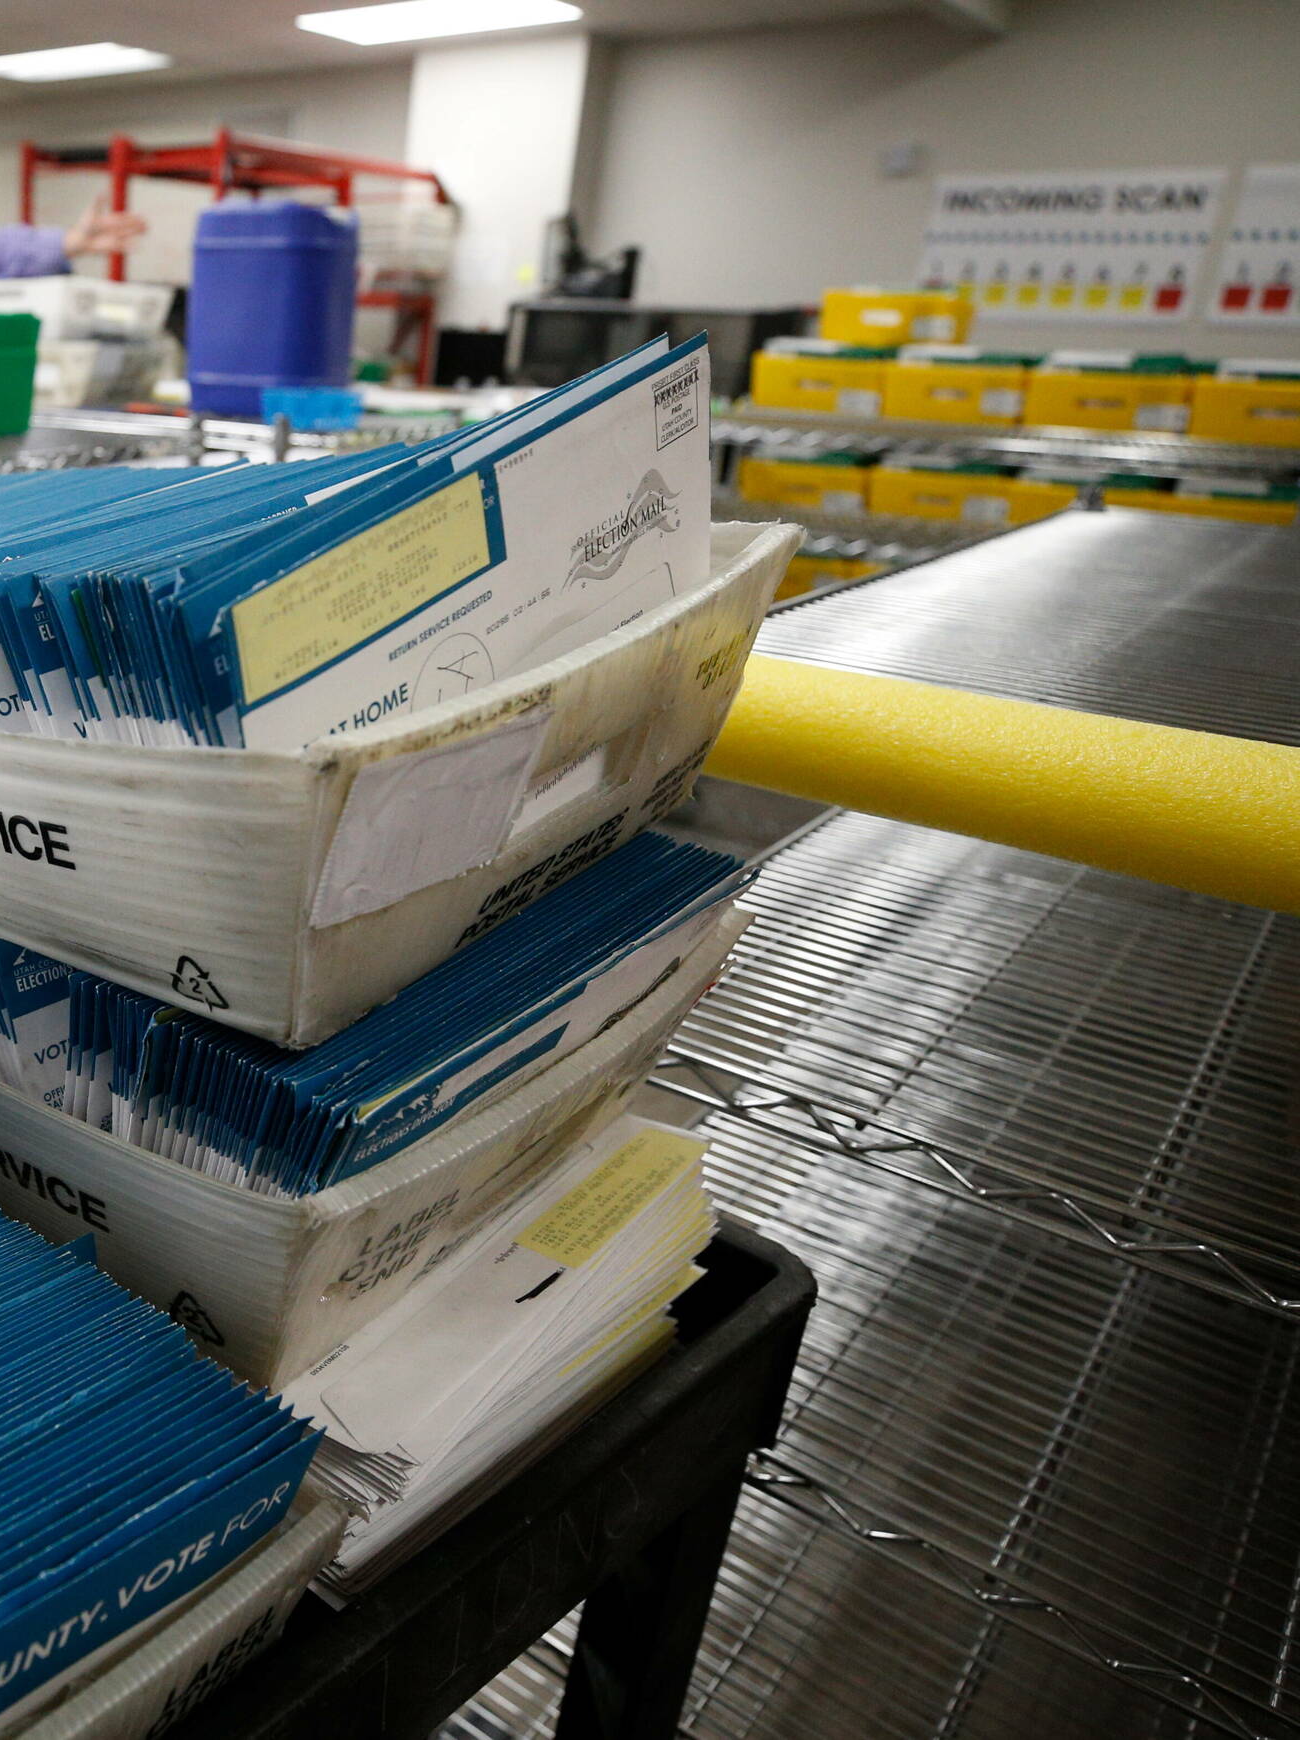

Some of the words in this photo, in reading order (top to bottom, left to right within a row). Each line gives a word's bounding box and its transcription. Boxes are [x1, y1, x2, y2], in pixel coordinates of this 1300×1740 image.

[946, 184, 1104, 215] INCOMING
[1115, 182, 1208, 214] SCAN
[674, 408, 692, 424] COUNTY
[576, 510, 625, 547] OFFICIAL
[639, 495, 667, 525] MAIL
[583, 516, 638, 562] ELECTION
[388, 636, 417, 662] RETURN
[419, 617, 451, 648] SERVICE
[451, 589, 493, 623] REQUESTED
[353, 682, 409, 731] HOME
[477, 856, 554, 916] UNITED
[552, 806, 626, 867] STATES
[454, 892, 533, 950] POSTAL
[538, 830, 622, 894] SERVICE
[13, 963, 36, 977] UTAH
[15, 963, 75, 993] ELECTIONS
[33, 1039, 71, 1065] VOT
[353, 1125, 411, 1163] ELECTIONS
[358, 1189, 460, 1257] LABEL
[117, 1533, 216, 1609] VOTE
[220, 1480, 290, 1548] FOR
[161, 1606, 275, 1715] LABEL
